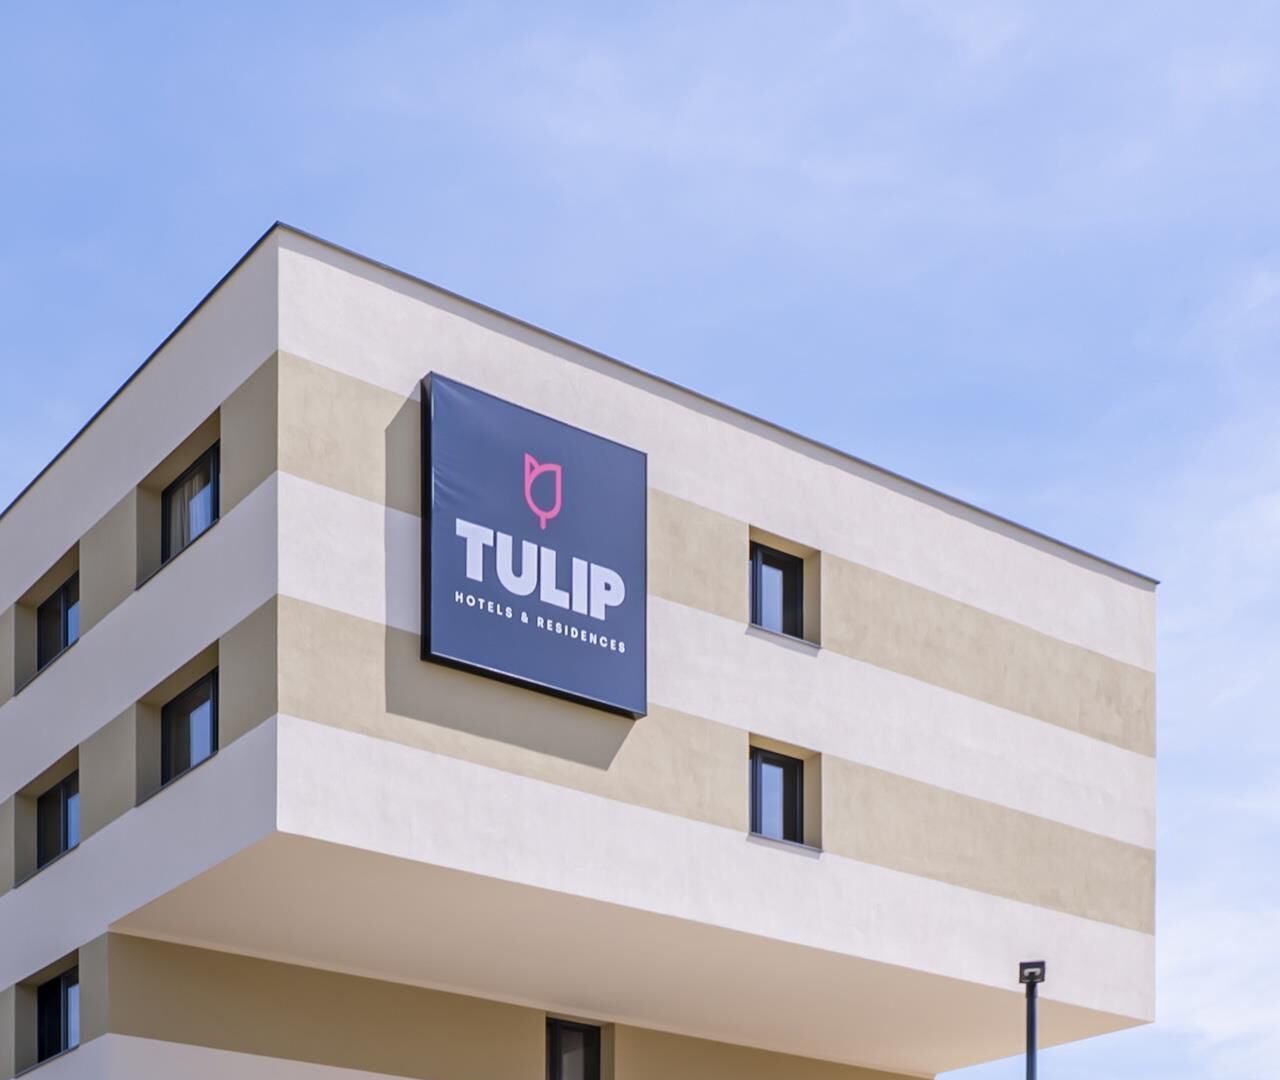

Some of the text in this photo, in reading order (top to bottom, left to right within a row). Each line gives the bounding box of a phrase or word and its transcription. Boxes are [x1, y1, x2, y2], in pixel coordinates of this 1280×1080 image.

[456, 518, 625, 621] TULIP
[455, 591, 626, 653] HOTELS & RESIDENCES
